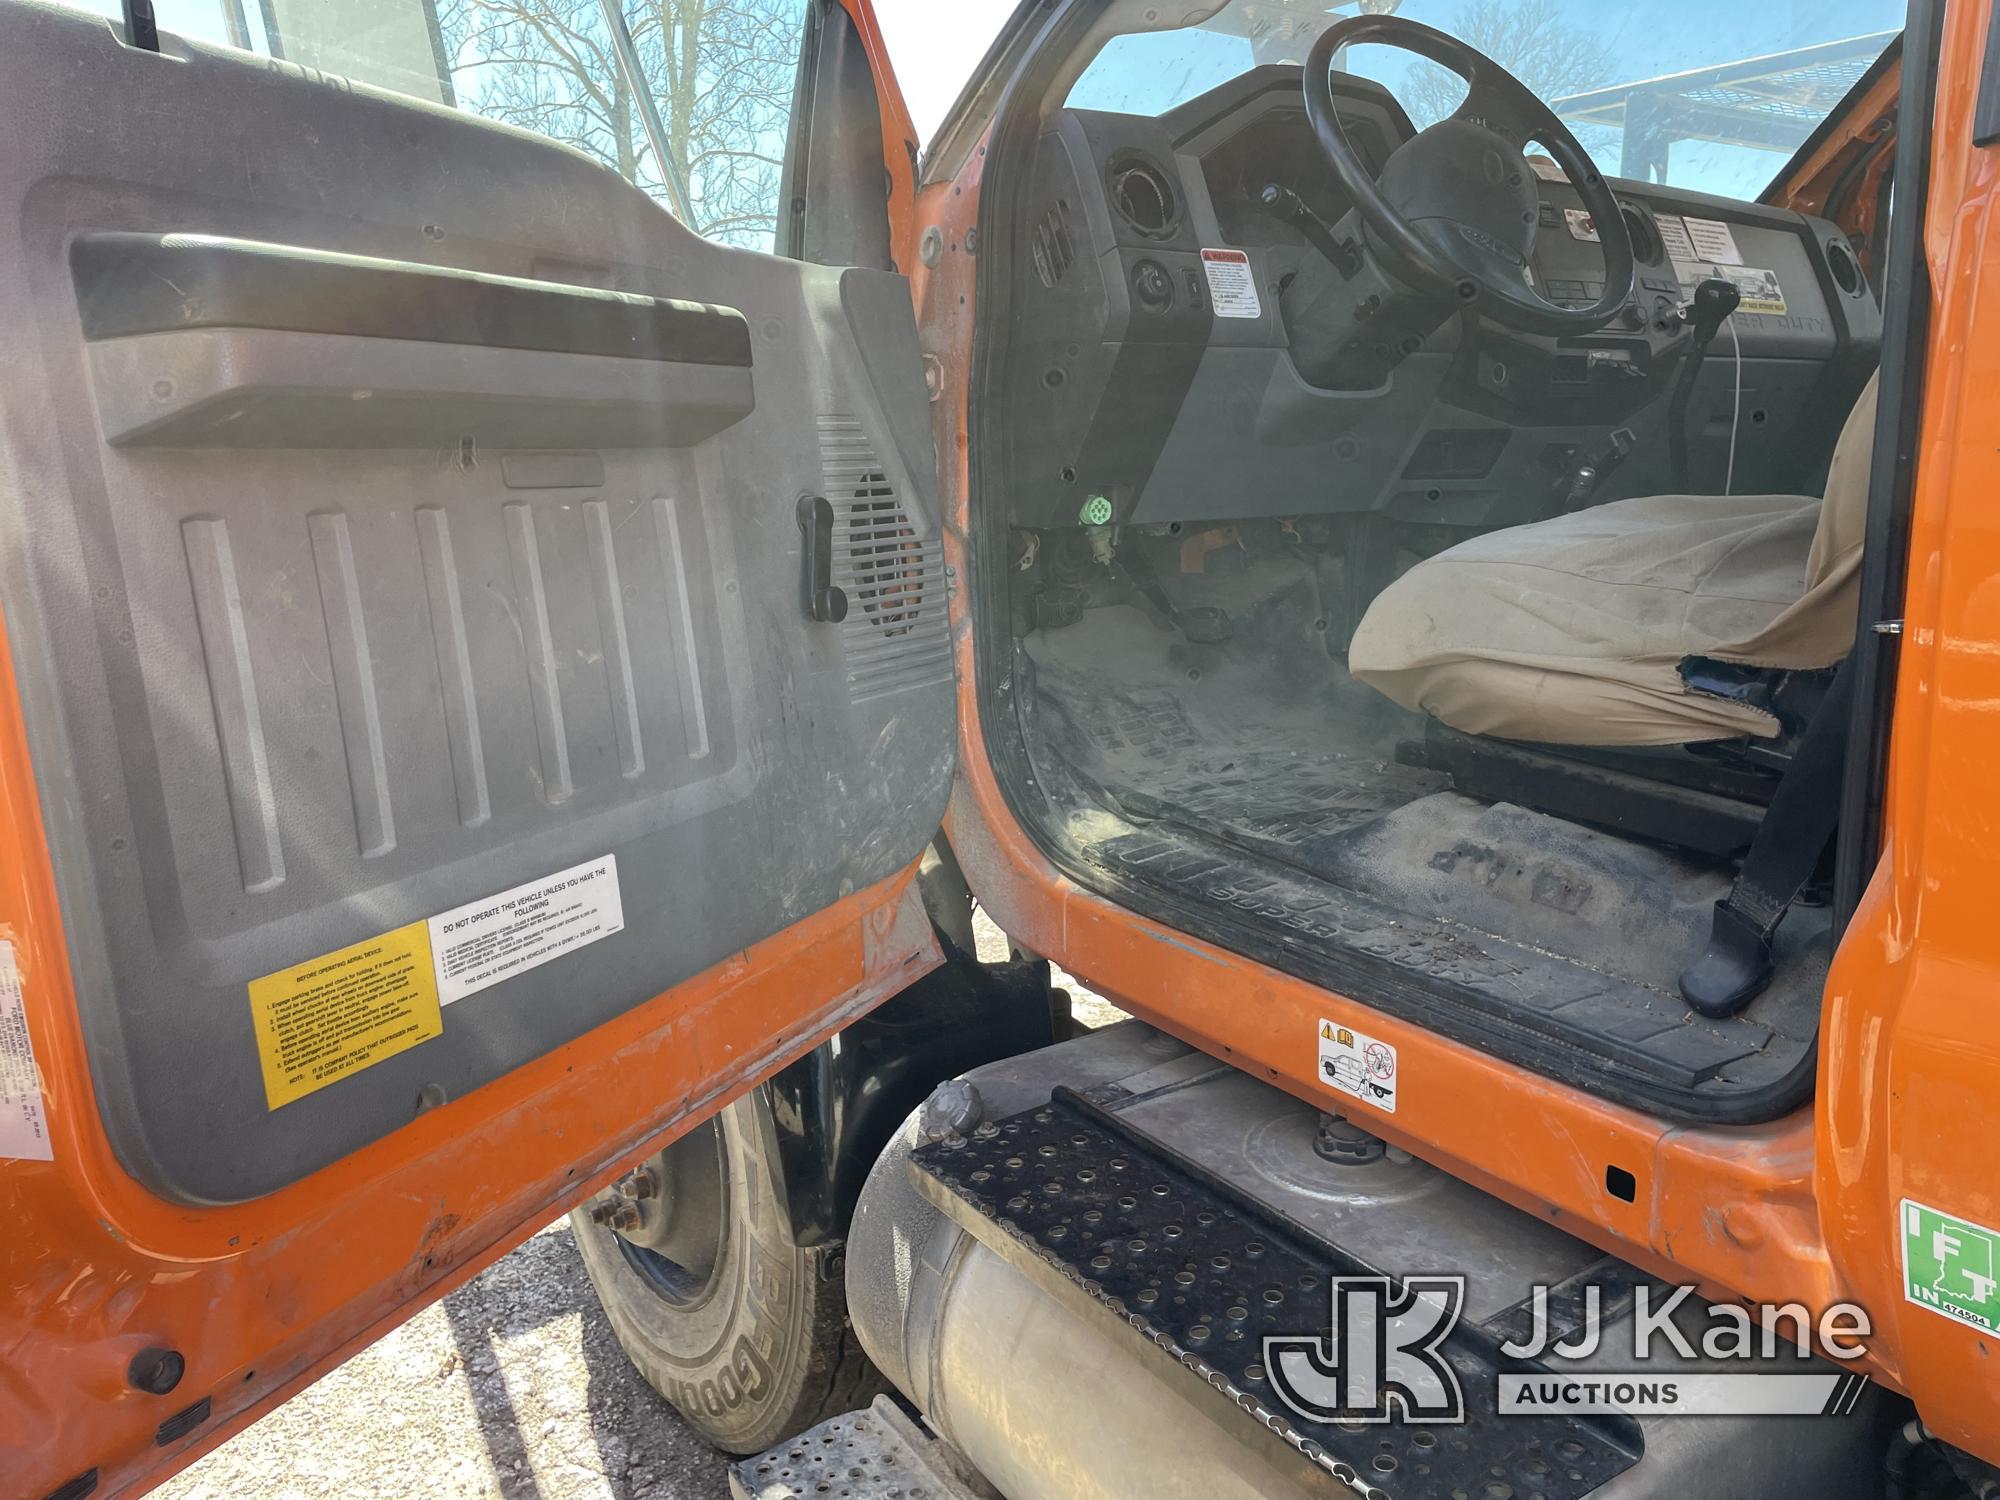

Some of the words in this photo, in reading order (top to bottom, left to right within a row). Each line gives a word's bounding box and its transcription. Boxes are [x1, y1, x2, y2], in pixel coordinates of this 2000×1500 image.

[471, 907, 500, 923] OPERATE
[501, 901, 516, 912] THIS
[517, 892, 542, 906] VEHICLE
[543, 883, 566, 896] UNLESS
[580, 872, 594, 883] HAVE
[514, 899, 549, 918] FOLLOWING
[1206, 886, 1339, 939] SUPER
[297, 971, 317, 983] BEFORE
[319, 961, 346, 974] OPERATING
[465, 977, 476, 985] THIS
[477, 971, 491, 980] DECAL
[498, 959, 520, 971] REQUIRED
[527, 948, 546, 959] VEHICLES
[11, 1007, 20, 1025] FORD
[13, 1026, 25, 1049] MOTOR
[325, 1055, 348, 1069] COMPANY
[349, 1047, 366, 1058] POLICY
[367, 1041, 379, 1050] THAT
[324, 1067, 338, 1077] USED
[1913, 1284, 1939, 1305] IN
[1944, 1303, 1986, 1325] 474504
